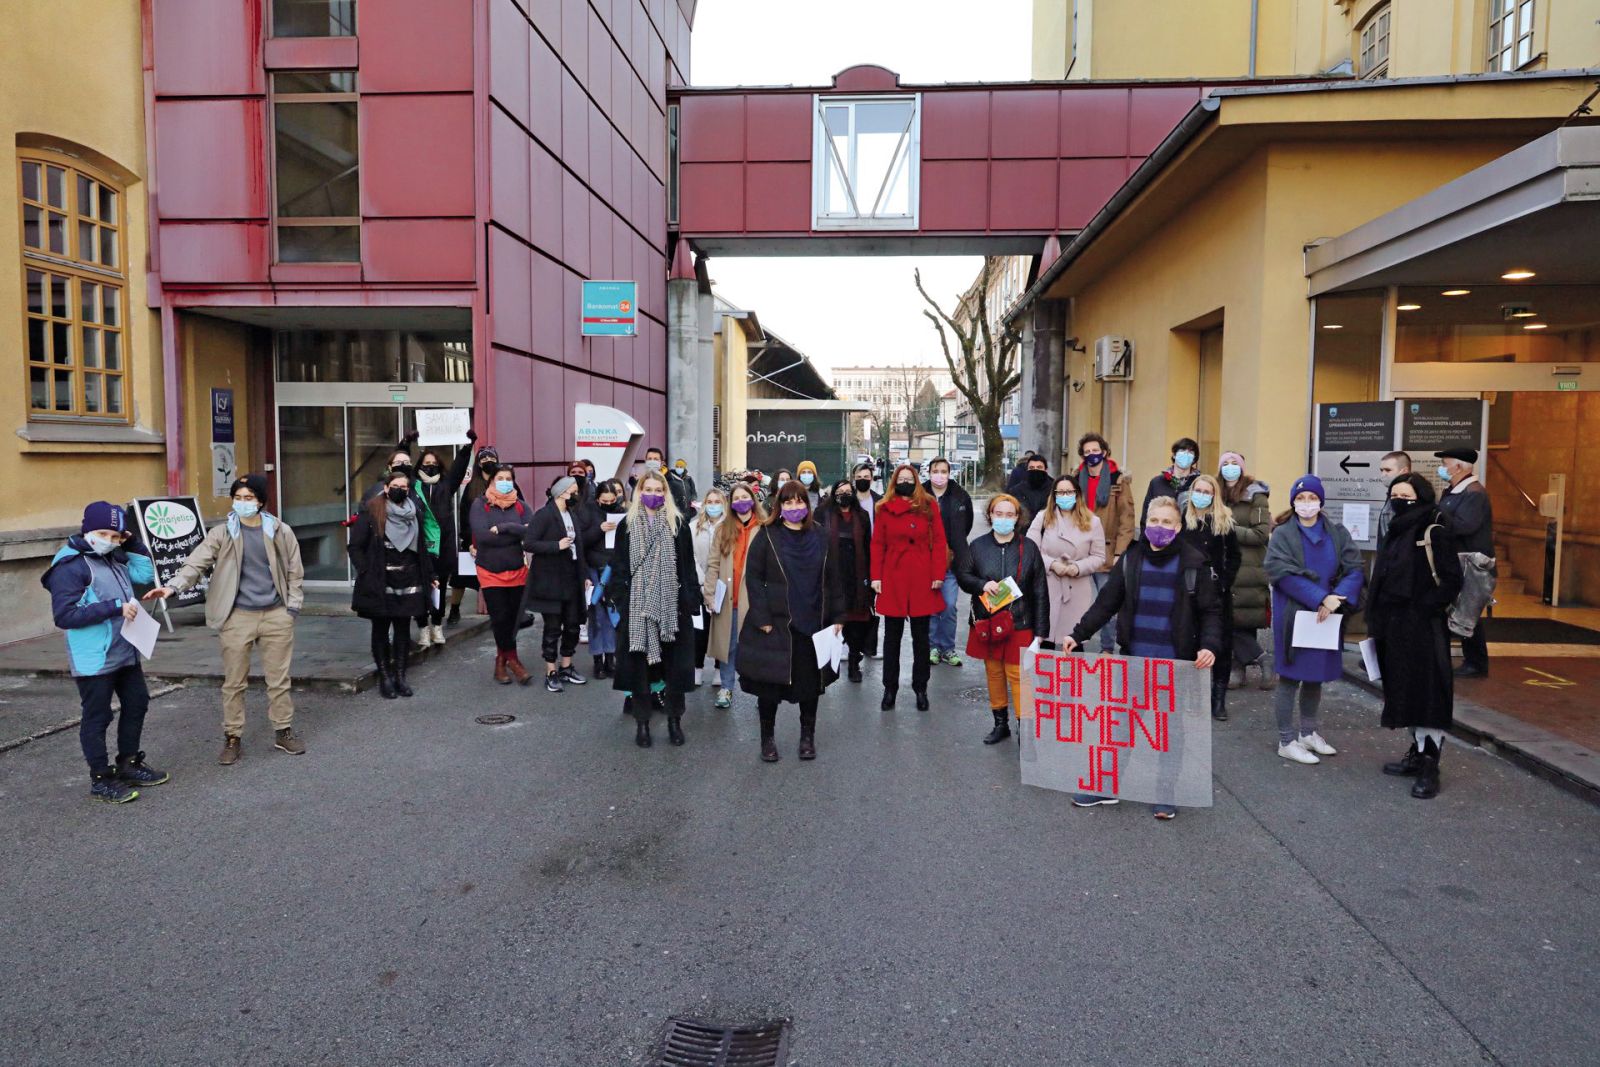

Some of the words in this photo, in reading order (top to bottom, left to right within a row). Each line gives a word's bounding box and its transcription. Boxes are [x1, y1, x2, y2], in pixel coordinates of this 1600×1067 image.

[159, 514, 194, 524] marjetica
[1035, 654, 1128, 704] SAMO
[1132, 656, 1174, 712] JA
[1035, 698, 1168, 752] POMENI
[1078, 745, 1118, 794] JA
